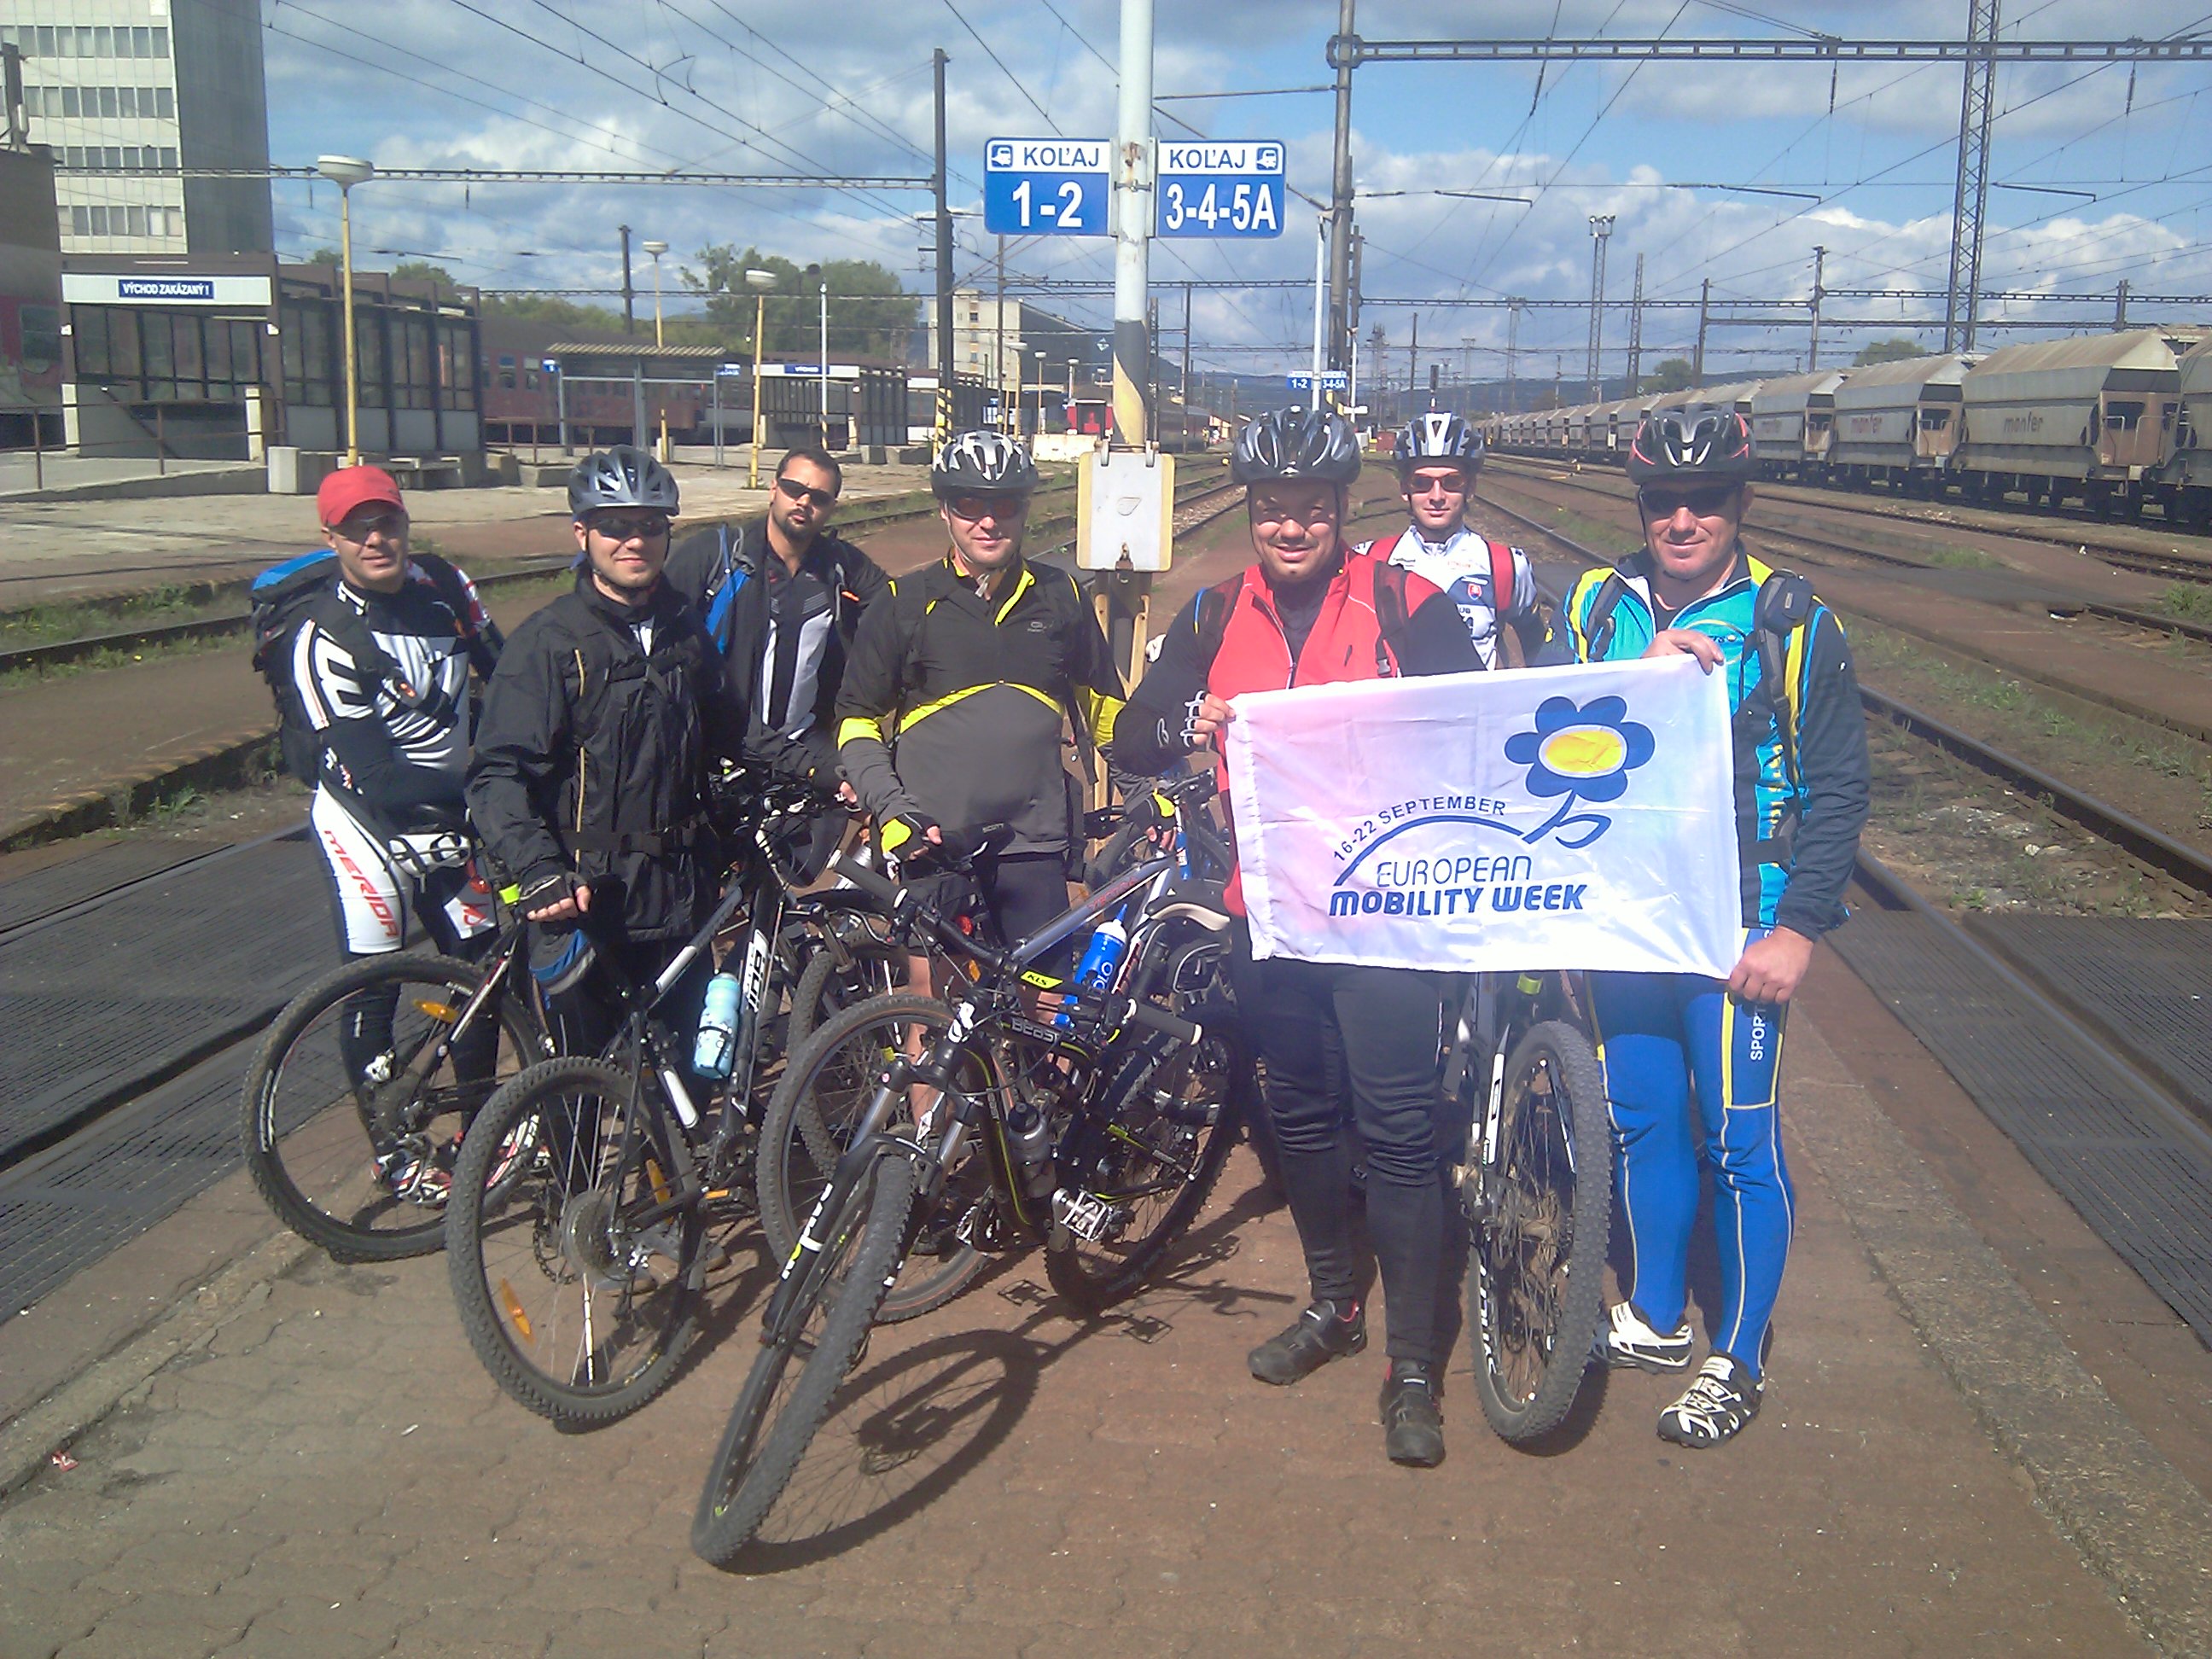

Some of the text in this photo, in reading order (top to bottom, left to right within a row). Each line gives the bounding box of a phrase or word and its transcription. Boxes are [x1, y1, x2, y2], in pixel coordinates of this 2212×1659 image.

[1024, 147, 1100, 168] KOĽAJ
[1169, 148, 1246, 169] KOĽAJ
[1011, 179, 1084, 229] 1-2
[1165, 182, 1278, 231] 3-4-5A
[1291, 378, 1308, 389] 1-2
[1332, 795, 1507, 862] 16-22 SEPTEMBER
[323, 830, 399, 937] MERIDA
[1376, 854, 1532, 888] EUROPEAN
[1328, 883, 1588, 917] MOBILITY WEEK
